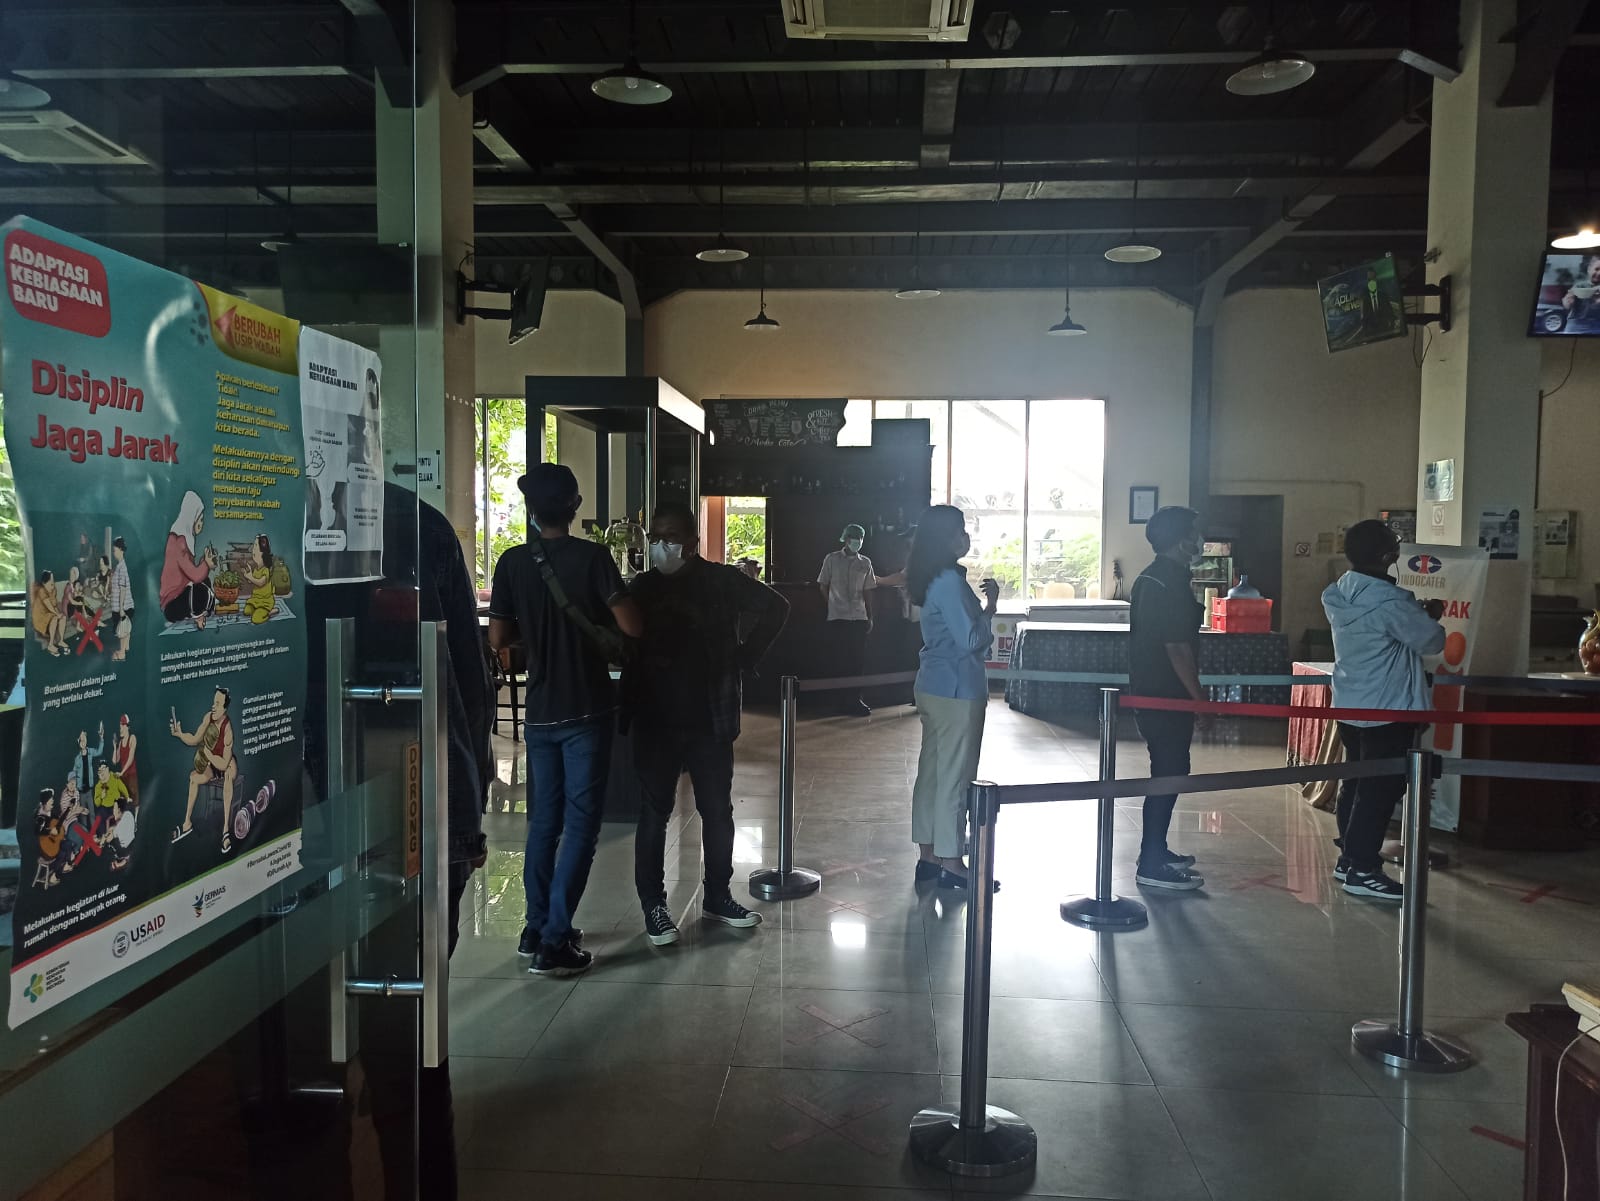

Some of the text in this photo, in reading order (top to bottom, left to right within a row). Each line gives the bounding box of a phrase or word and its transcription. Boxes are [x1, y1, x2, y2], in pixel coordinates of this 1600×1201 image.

[9, 243, 89, 285] ADAPTASI
[10, 262, 103, 307] KEBIASAAN
[12, 283, 59, 312] BARU
[234, 313, 281, 344] BERUBAH
[32, 359, 144, 414] Disiplin
[217, 396, 235, 409] Jaga
[216, 409, 255, 424] keharusan
[30, 414, 179, 464] Jaga Jarak
[215, 421, 260, 438] kita berada.
[213, 444, 295, 465] Melakukannya dengan
[212, 457, 300, 478] disiplin akan melindungi
[226, 471, 241, 481] kita
[242, 473, 277, 487] sekaligus
[213, 485, 262, 498] menekan laju
[213, 497, 281, 509] penyebaran wabah
[1400, 574, 1446, 589] INDOCATER
[1441, 600, 1471, 619] RAK
[161, 651, 187, 661] Lakukan
[187, 648, 211, 658] kegiatan
[212, 645, 226, 655] yang
[161, 660, 202, 673] menyehatkan
[202, 656, 225, 666] bersama
[182, 671, 198, 680] serta
[198, 667, 219, 678] hindari
[44, 673, 117, 695] Berkumpul dalam jarak
[42, 688, 104, 711] yang terlalu dekat.
[409, 747, 417, 853] DORONG
[23, 884, 120, 935] Melakukan kegiatan di luar
[23, 893, 127, 948] rumah dengan banyak orang.
[131, 914, 166, 942] USAID
